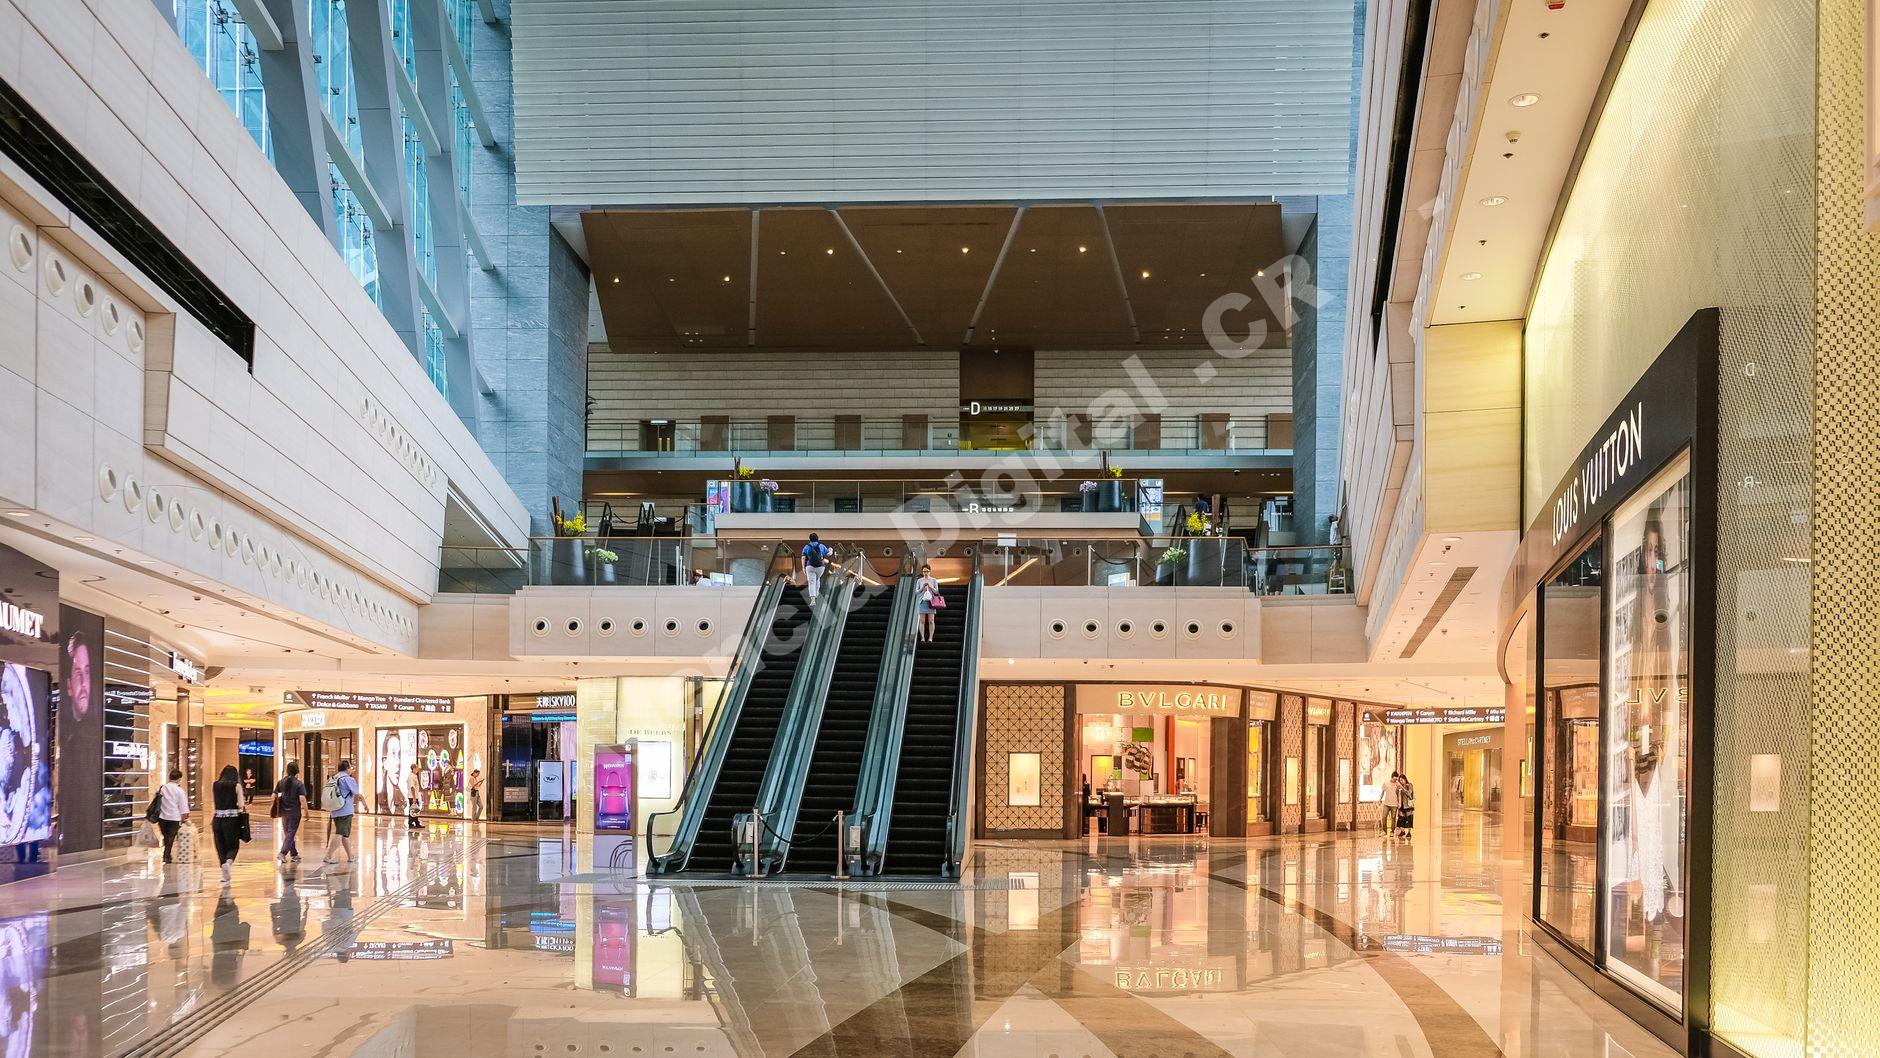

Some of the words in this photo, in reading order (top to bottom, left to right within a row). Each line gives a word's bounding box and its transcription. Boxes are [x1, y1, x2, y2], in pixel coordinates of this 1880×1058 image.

[970, 402, 980, 415] D
[1552, 477, 1579, 546] LOUIS
[1582, 401, 1642, 515] VUITTON
[1118, 691, 1228, 710] BVLGARI
